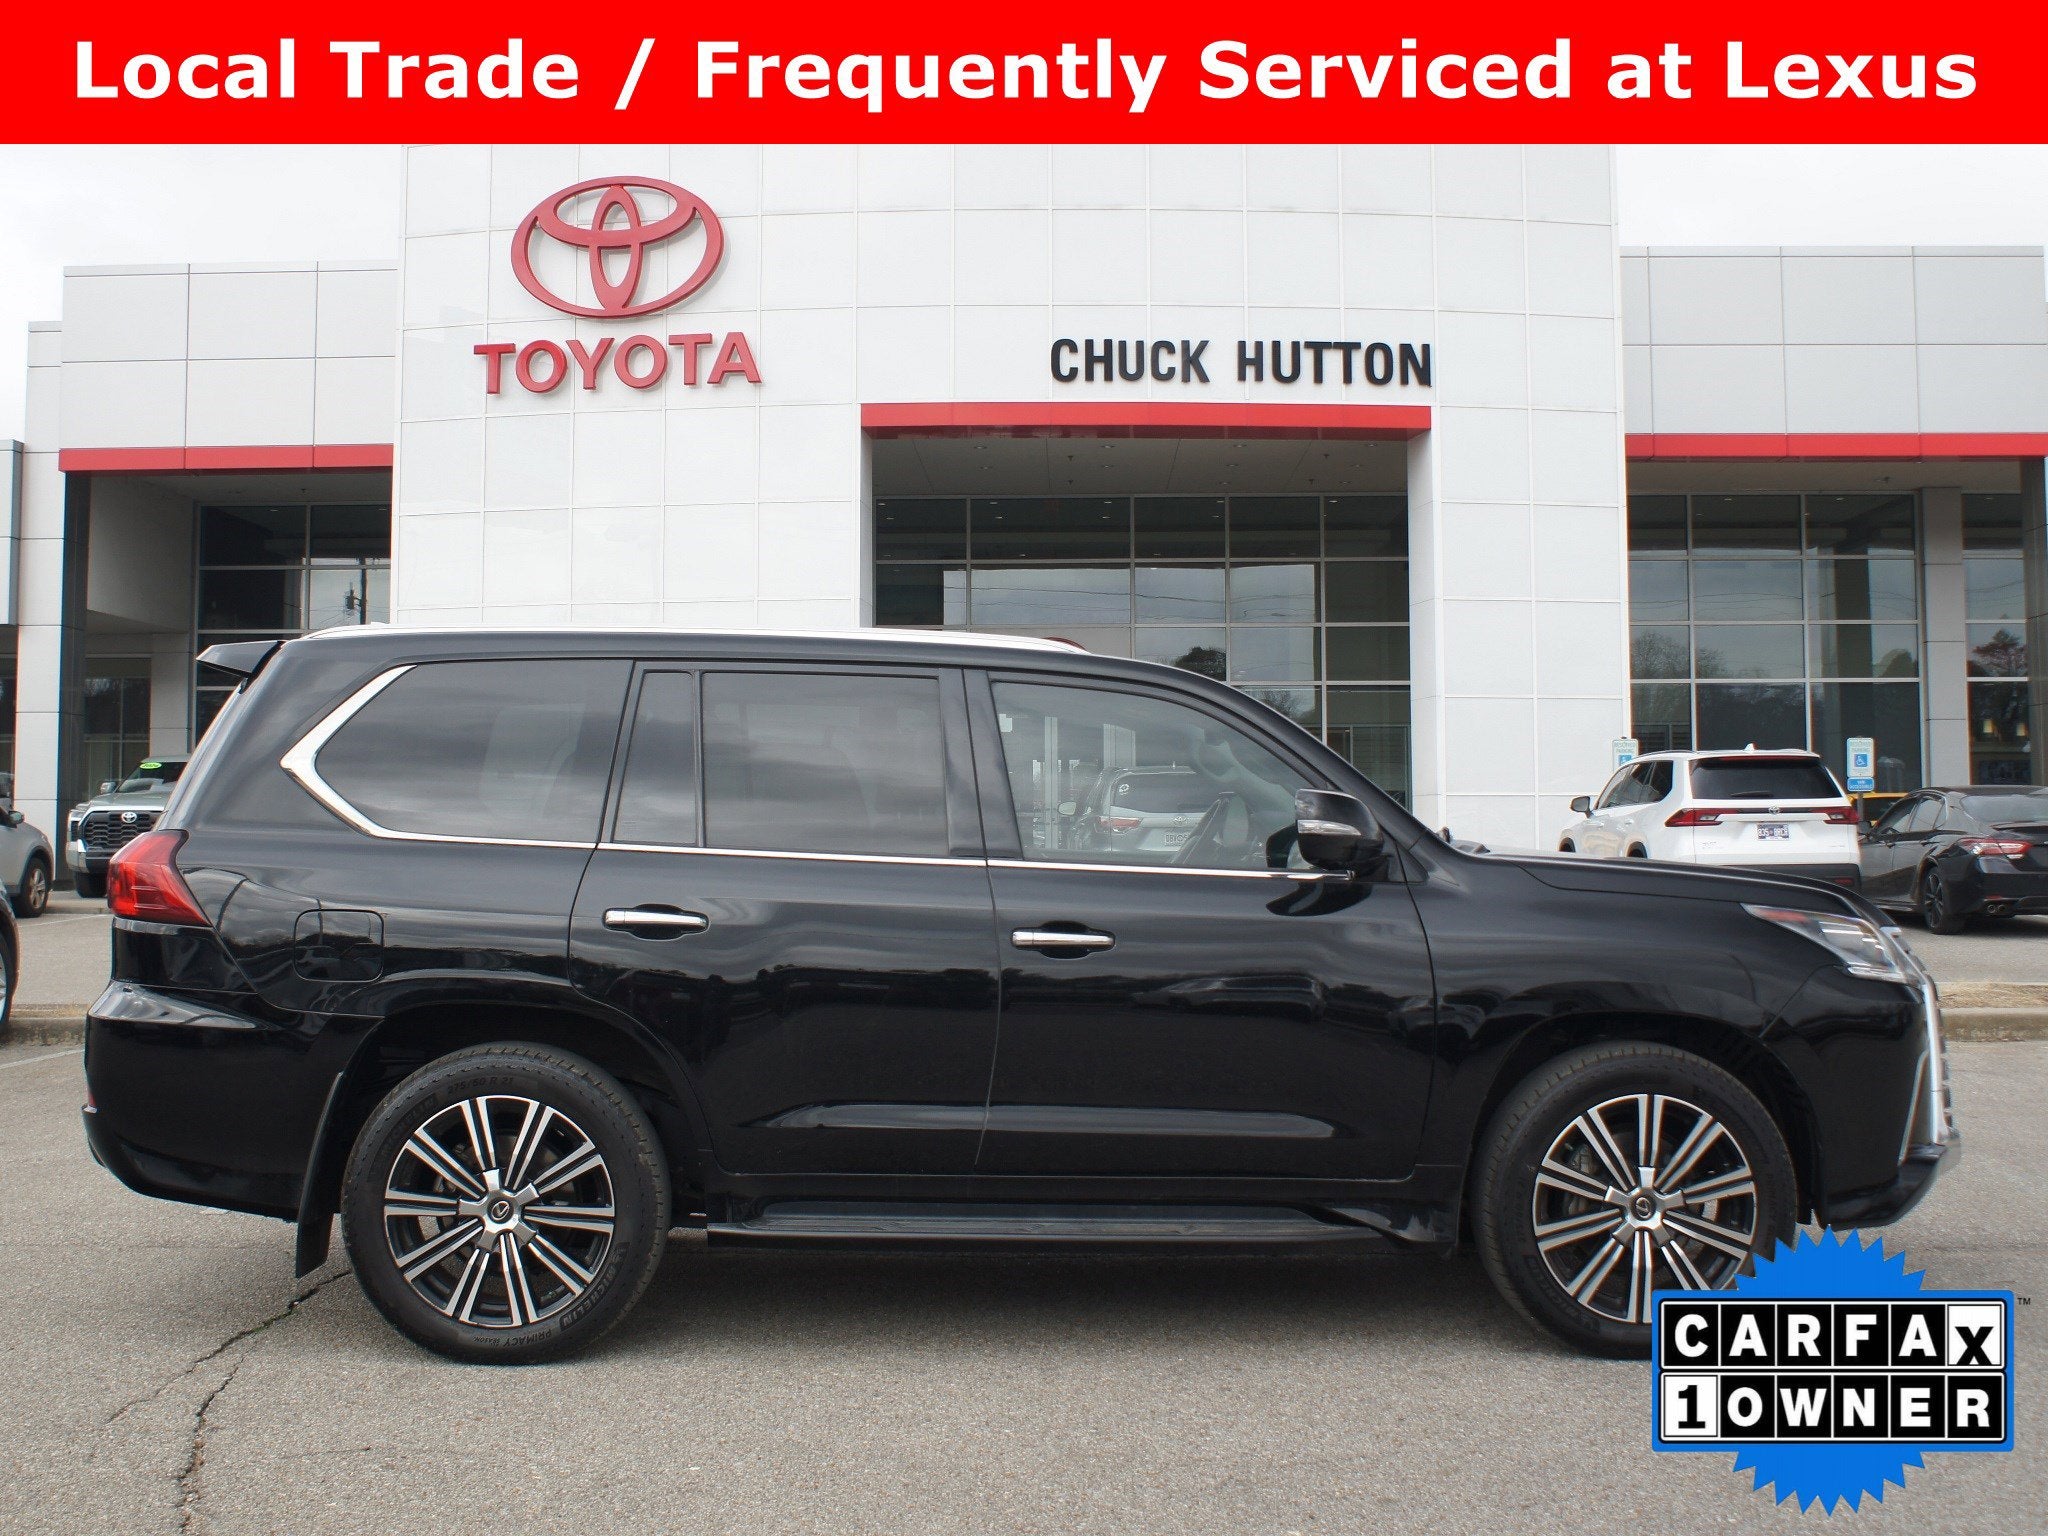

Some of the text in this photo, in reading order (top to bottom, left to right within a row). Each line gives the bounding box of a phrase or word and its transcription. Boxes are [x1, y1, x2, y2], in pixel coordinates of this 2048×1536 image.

[473, 332, 762, 394] TOYOTA
[1051, 339, 1432, 387] CHUCK HUTTON
[503, 1328, 552, 1347] PRIMACY
